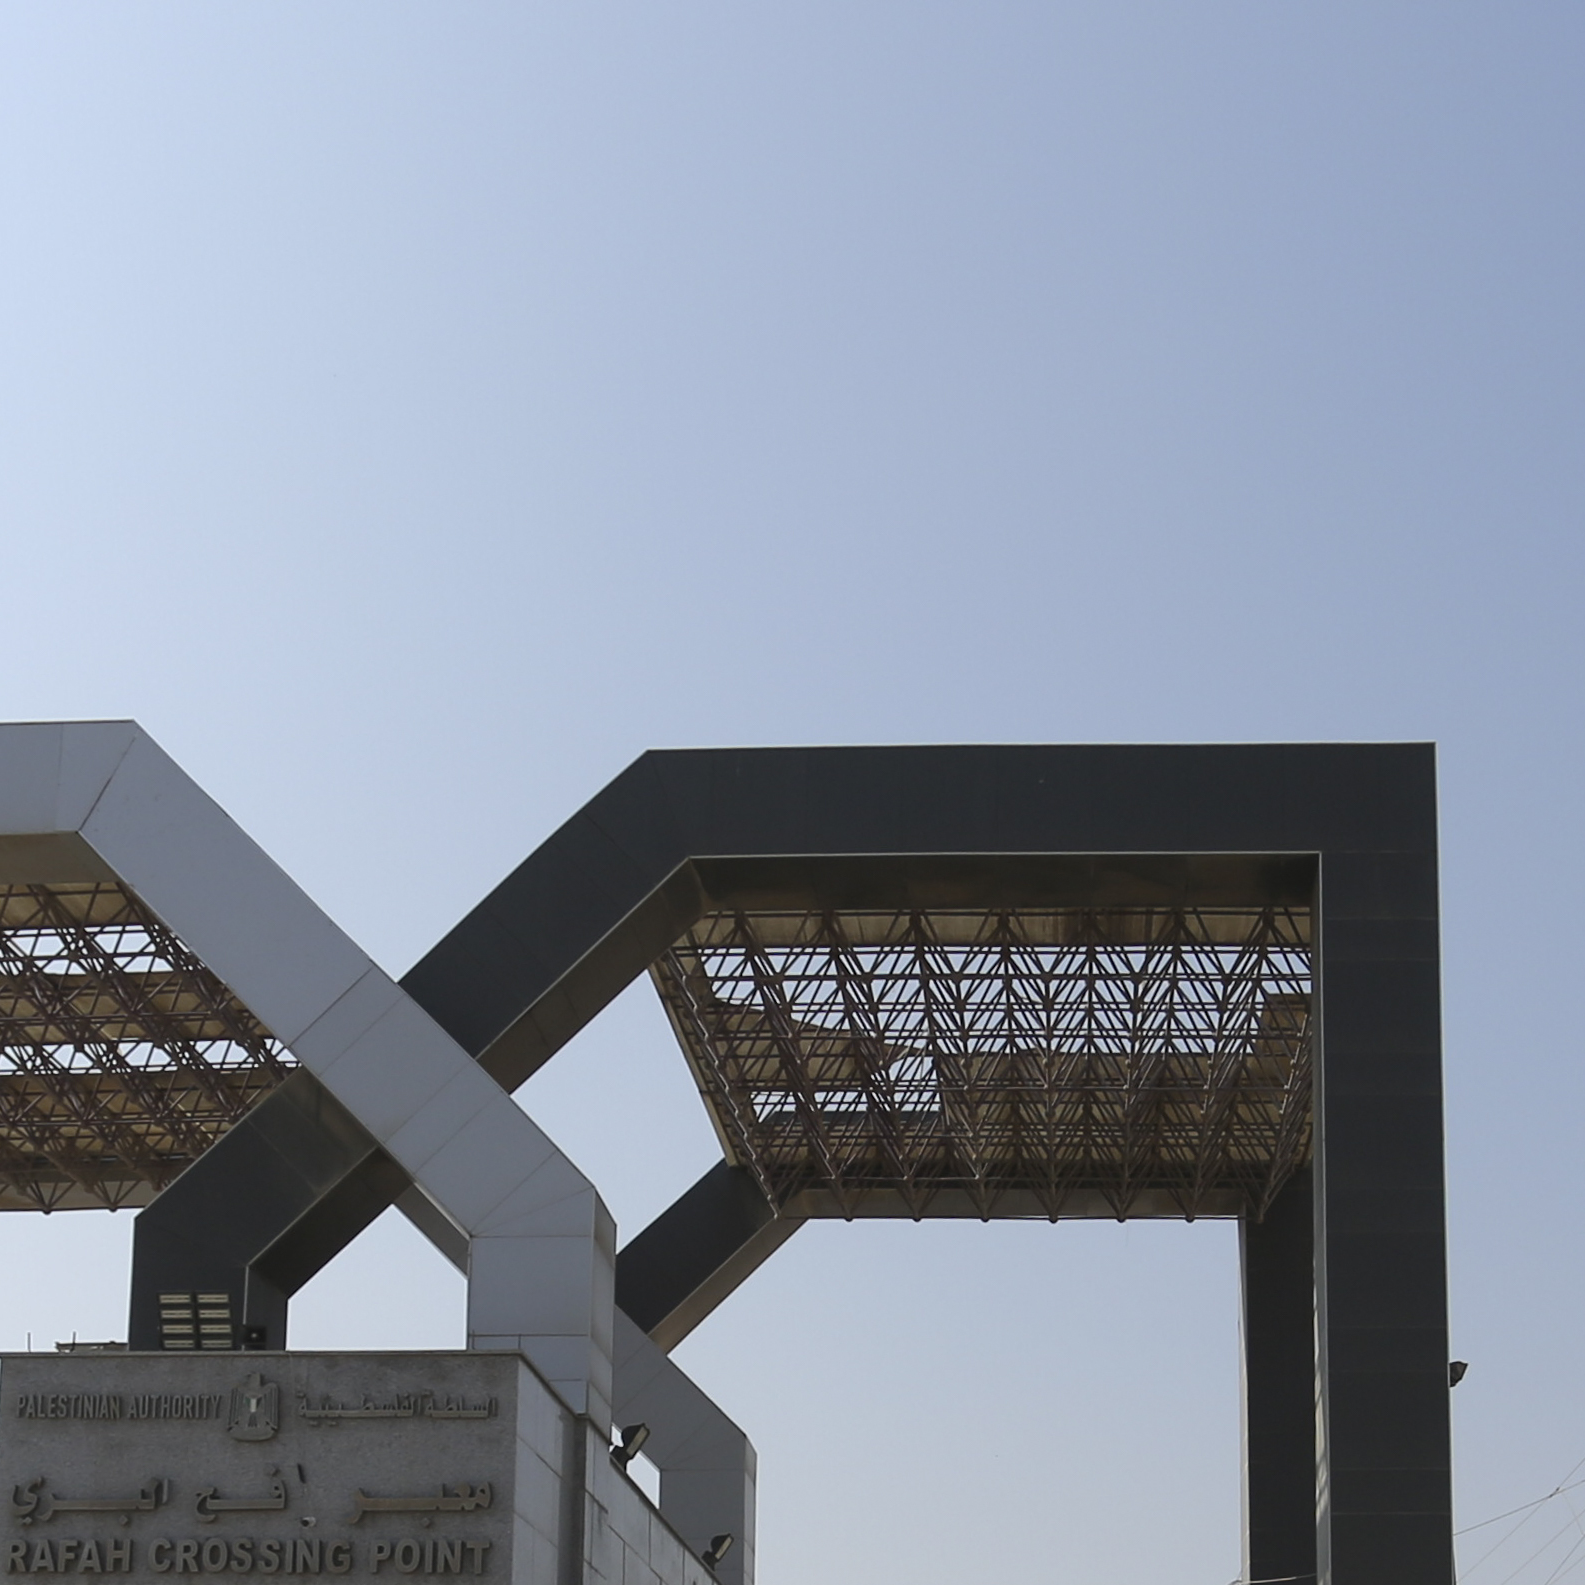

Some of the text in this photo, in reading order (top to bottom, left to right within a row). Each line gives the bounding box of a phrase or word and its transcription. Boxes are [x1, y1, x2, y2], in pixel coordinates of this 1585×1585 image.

[16, 1394, 223, 1420] PALESTINIAN AUTHORITY
[11, 1475, 172, 1526] البري
[345, 1480, 494, 1528] معبر
[7, 1537, 492, 1575] RAFAH CROSSING POINT
